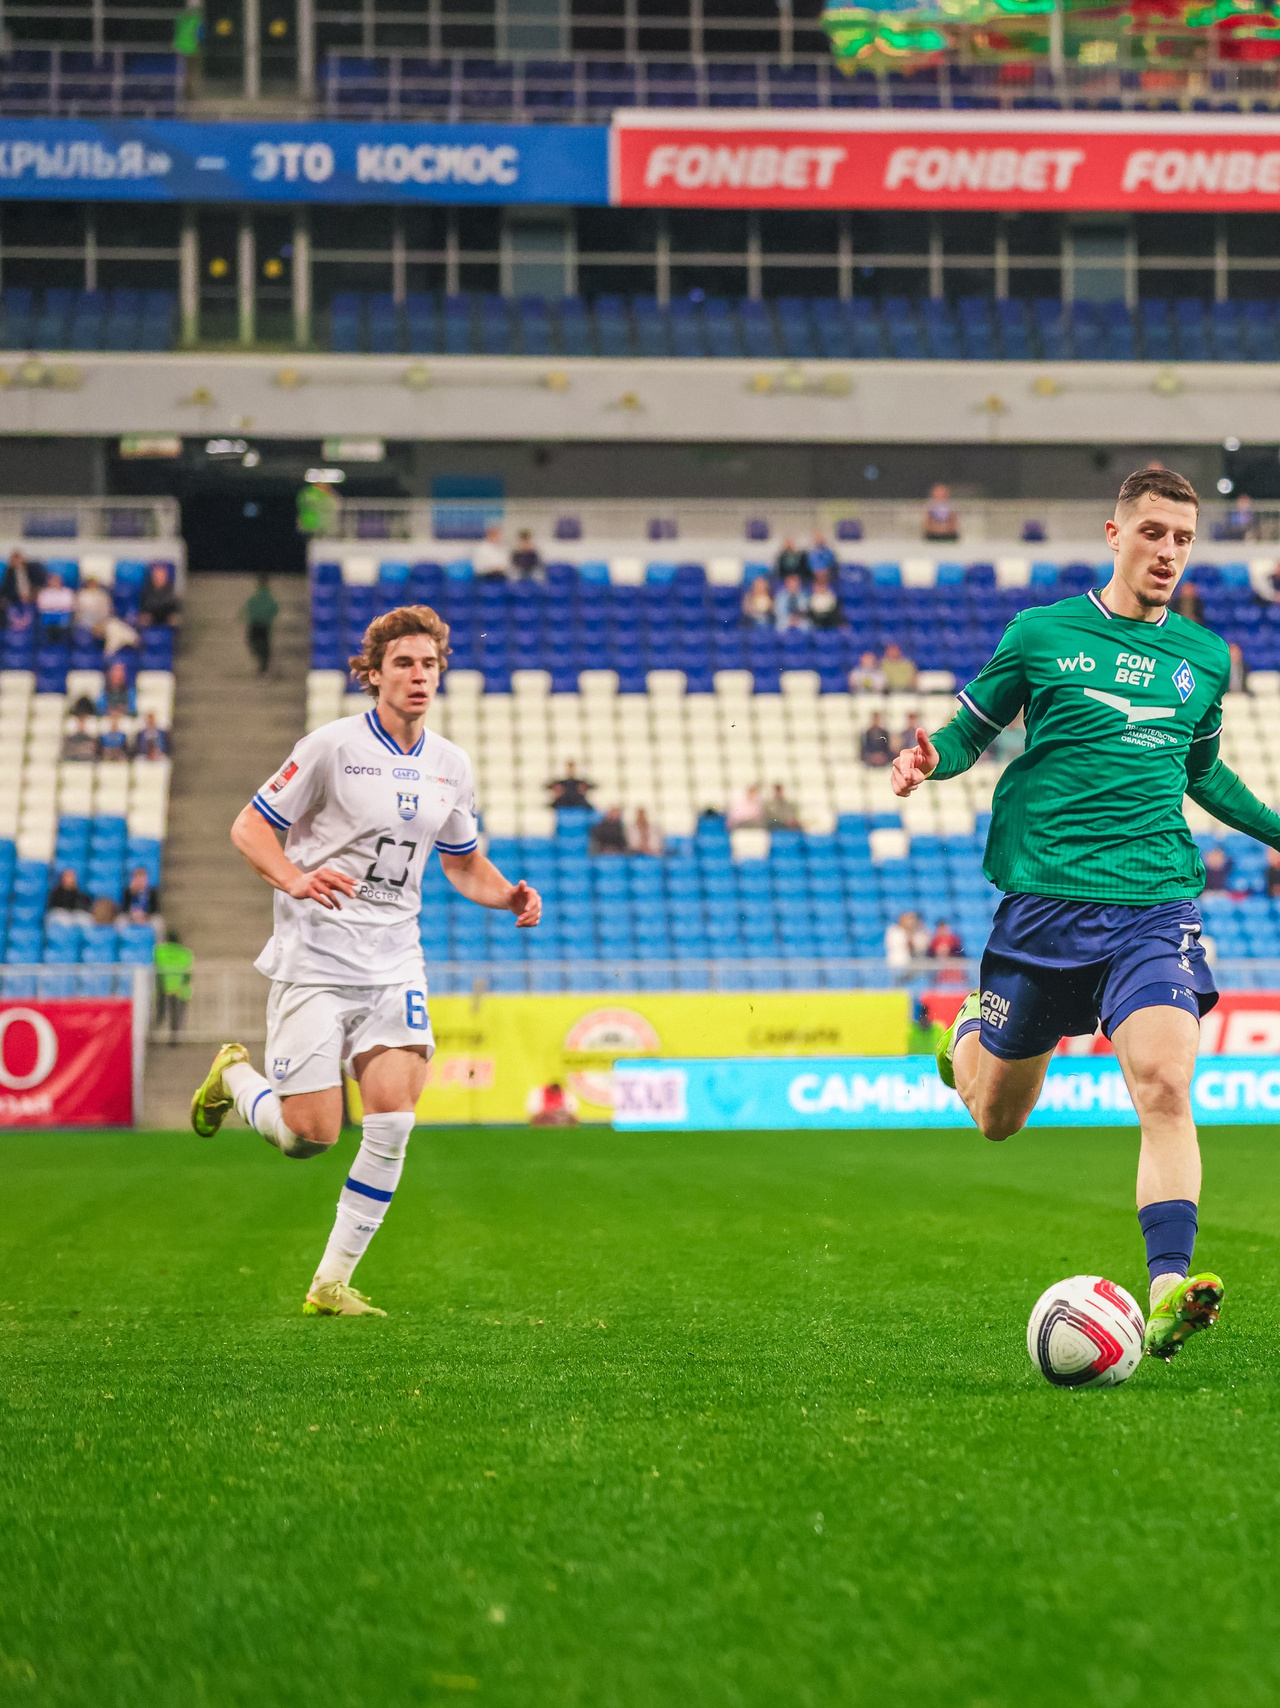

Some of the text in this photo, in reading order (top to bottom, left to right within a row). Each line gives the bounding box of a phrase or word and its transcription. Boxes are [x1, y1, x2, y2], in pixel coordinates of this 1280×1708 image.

[252, 142, 335, 183] ЭТО
[356, 144, 518, 185] КОСМОС
[645, 146, 846, 188] FONBET
[885, 149, 1085, 191] FONBET
[1056, 651, 1096, 672] wb
[1115, 652, 1157, 673] FON
[1114, 668, 1156, 688] BET
[1120, 735, 1156, 749] ОБЛАСТИ
[358, 885, 400, 902] Ростех
[980, 990, 1011, 1015] FON
[1171, 987, 1178, 1001] 7
[405, 989, 429, 1030] 6
[981, 1005, 1009, 1030] BET
